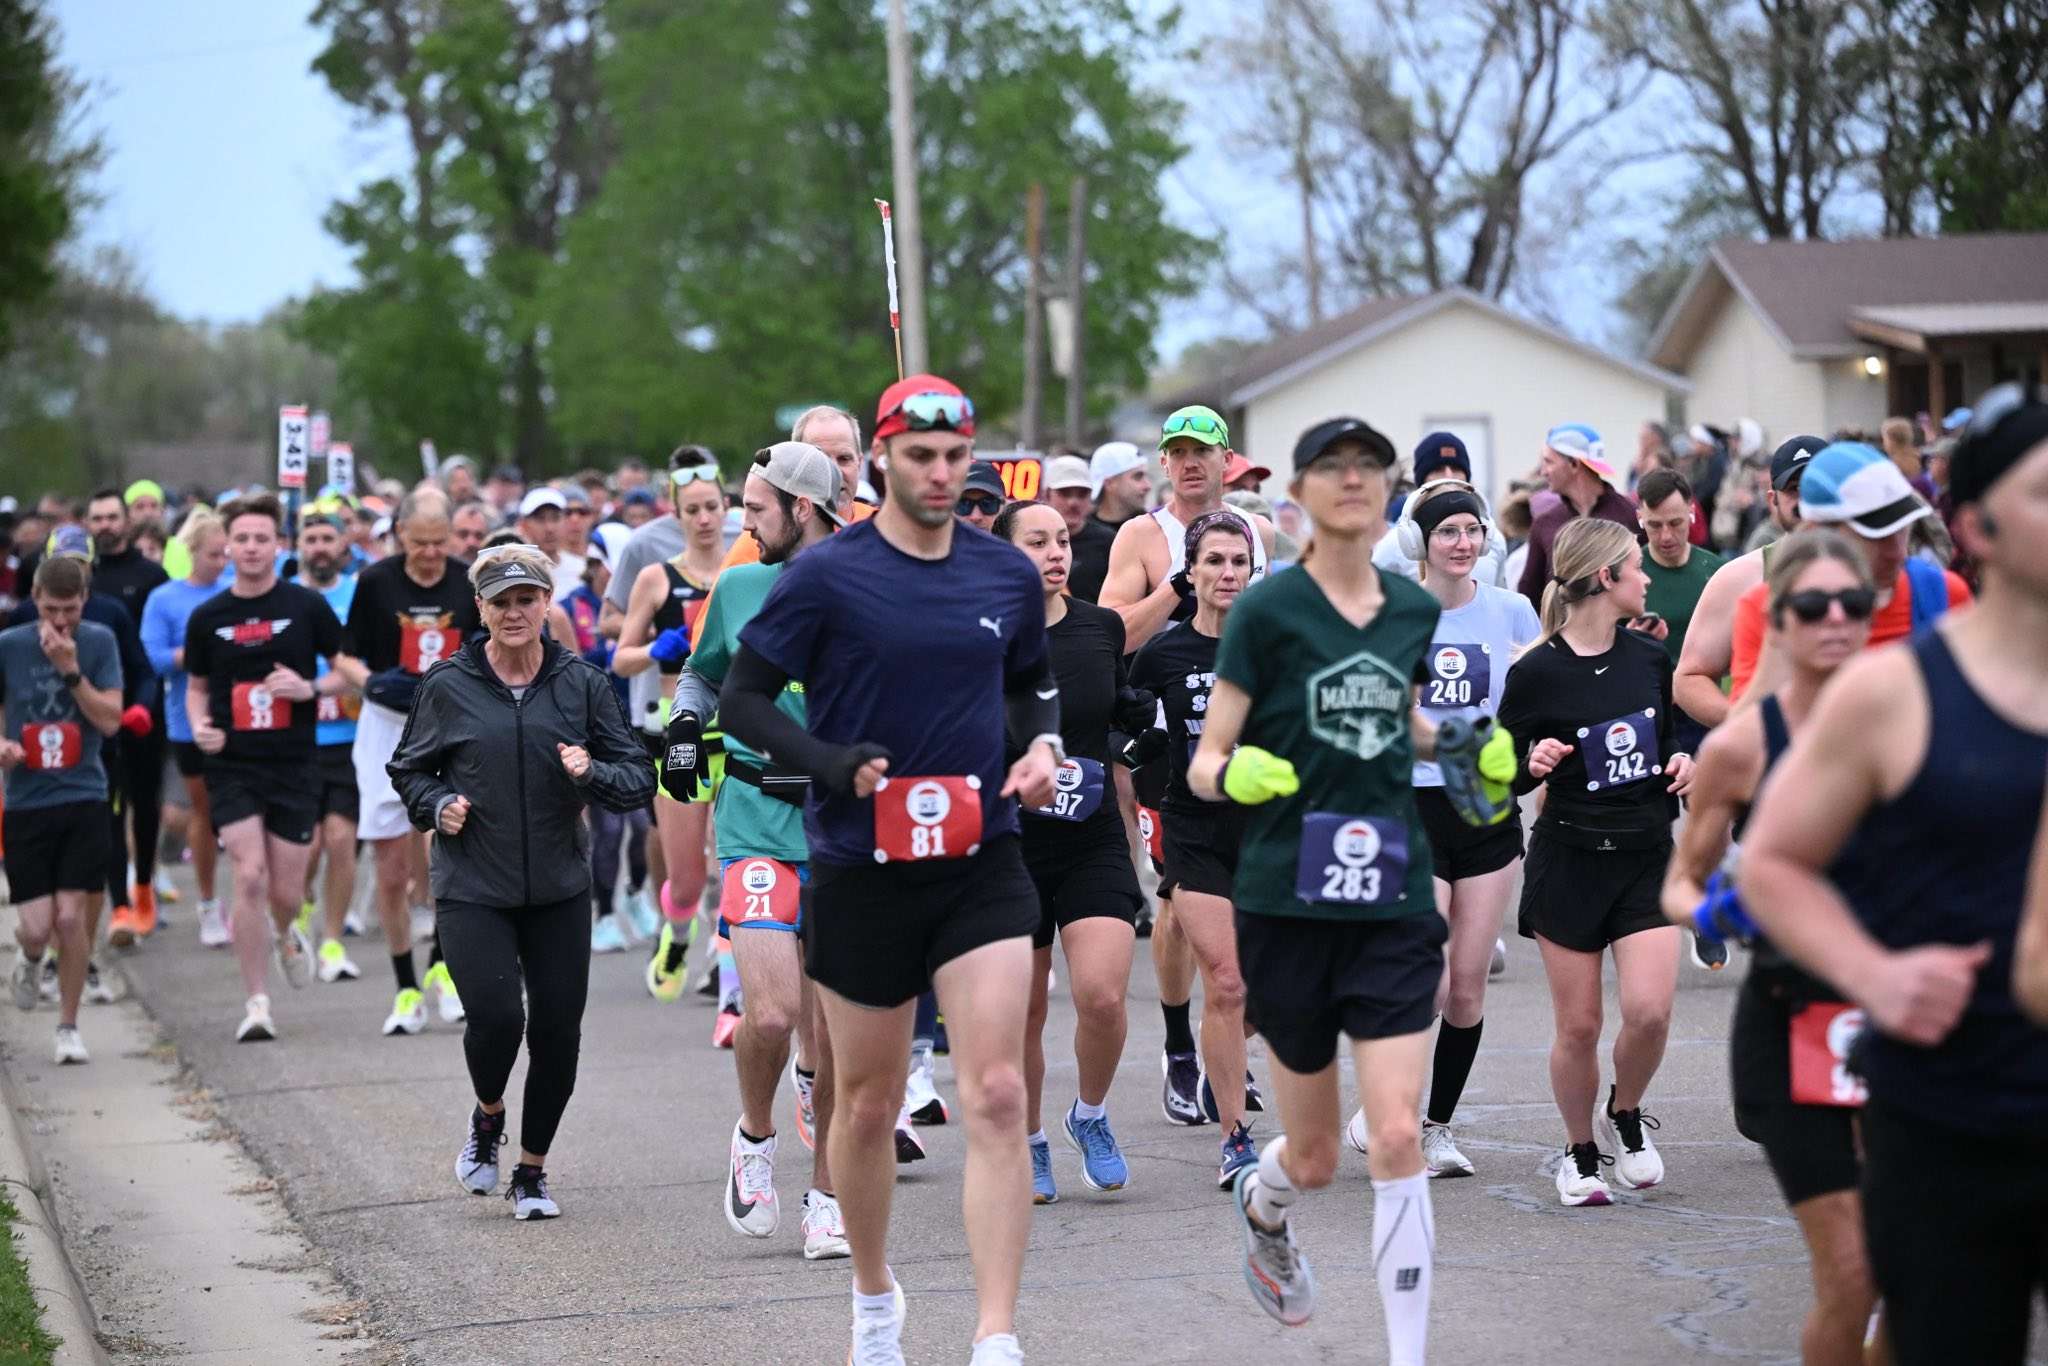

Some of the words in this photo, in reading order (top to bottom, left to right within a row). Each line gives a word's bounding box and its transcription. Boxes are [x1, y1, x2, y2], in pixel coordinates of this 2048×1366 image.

[286, 422, 302, 469] 3:45
[1443, 661, 1458, 669] IKE
[1320, 685, 1401, 712] MARATHON
[1430, 679, 1472, 703] 240
[1613, 735, 1628, 746] IKE
[1058, 772, 1075, 782] IKE
[1605, 751, 1648, 783] 242
[1039, 791, 1084, 817] 97
[910, 824, 946, 858] 81
[751, 874, 767, 884] IKE
[1321, 864, 1382, 901] 283
[744, 894, 772, 918] 21
